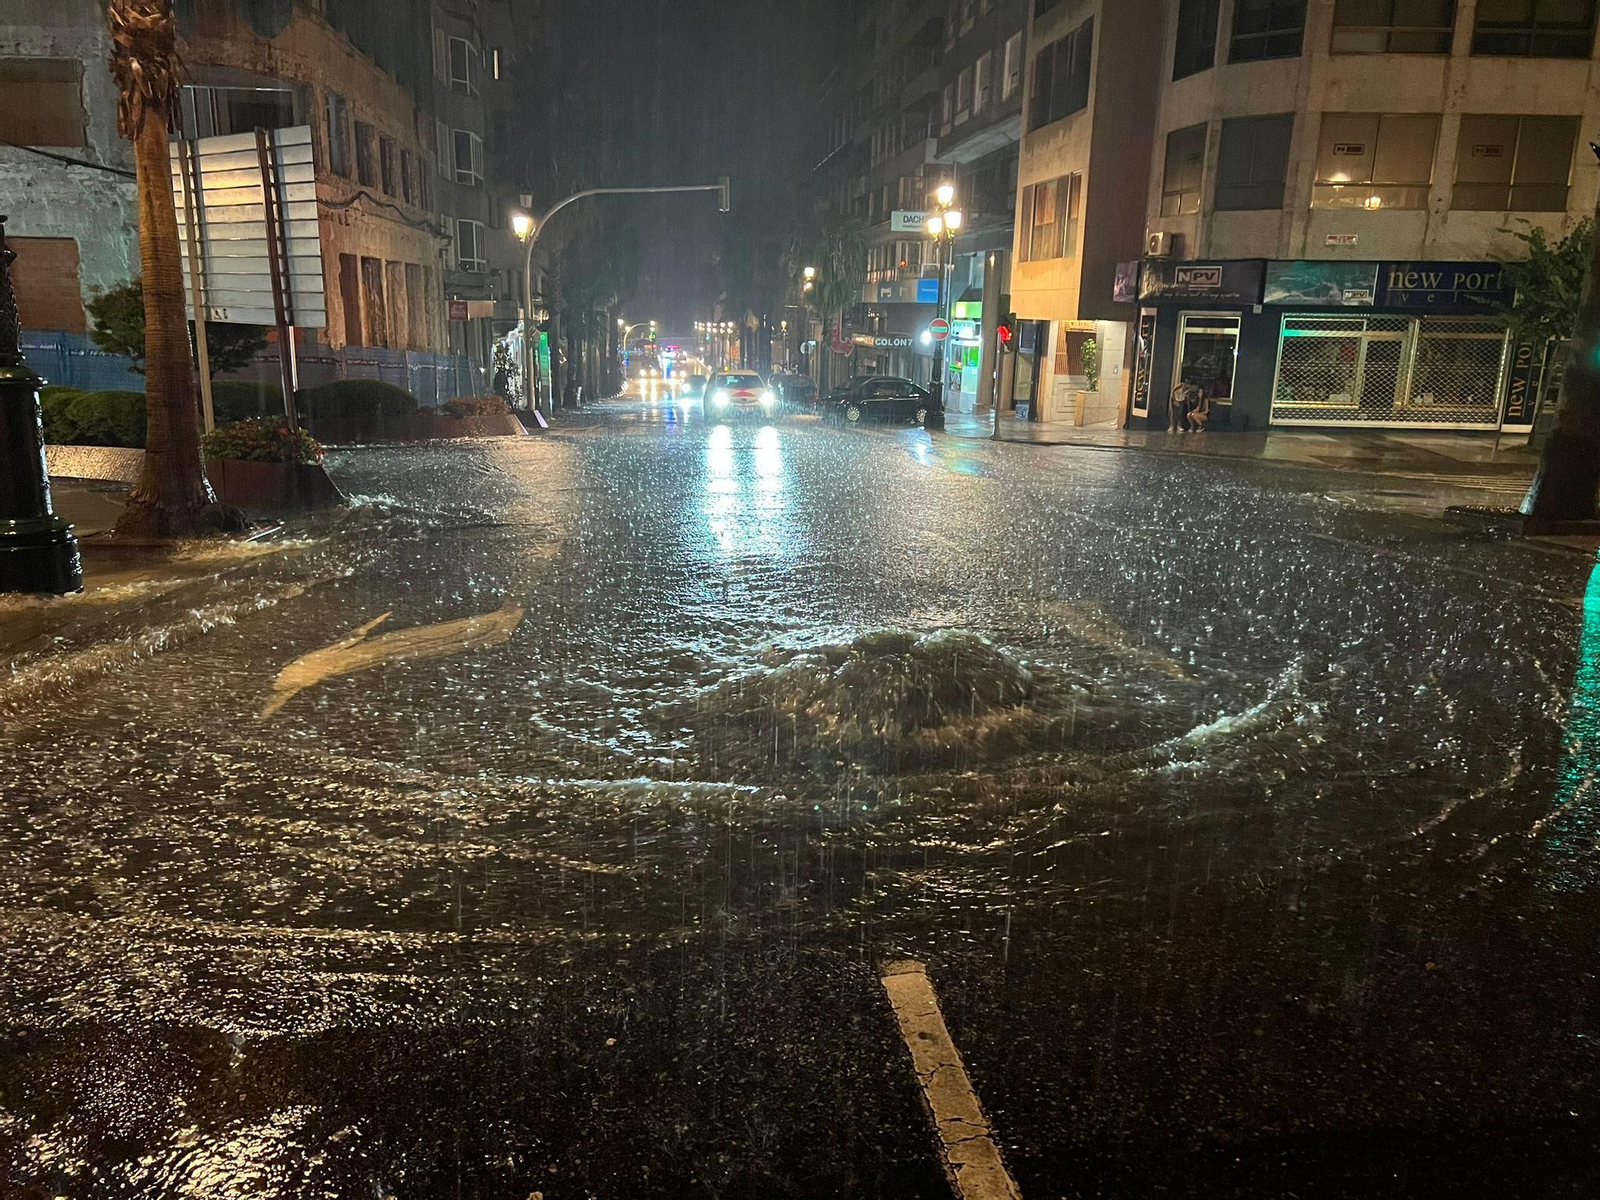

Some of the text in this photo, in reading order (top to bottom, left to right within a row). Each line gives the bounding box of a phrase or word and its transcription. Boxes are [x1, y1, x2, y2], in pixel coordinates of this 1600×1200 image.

[1178, 271, 1216, 281] NPV
[1388, 271, 1443, 289] new
[1508, 376, 1526, 417] new
